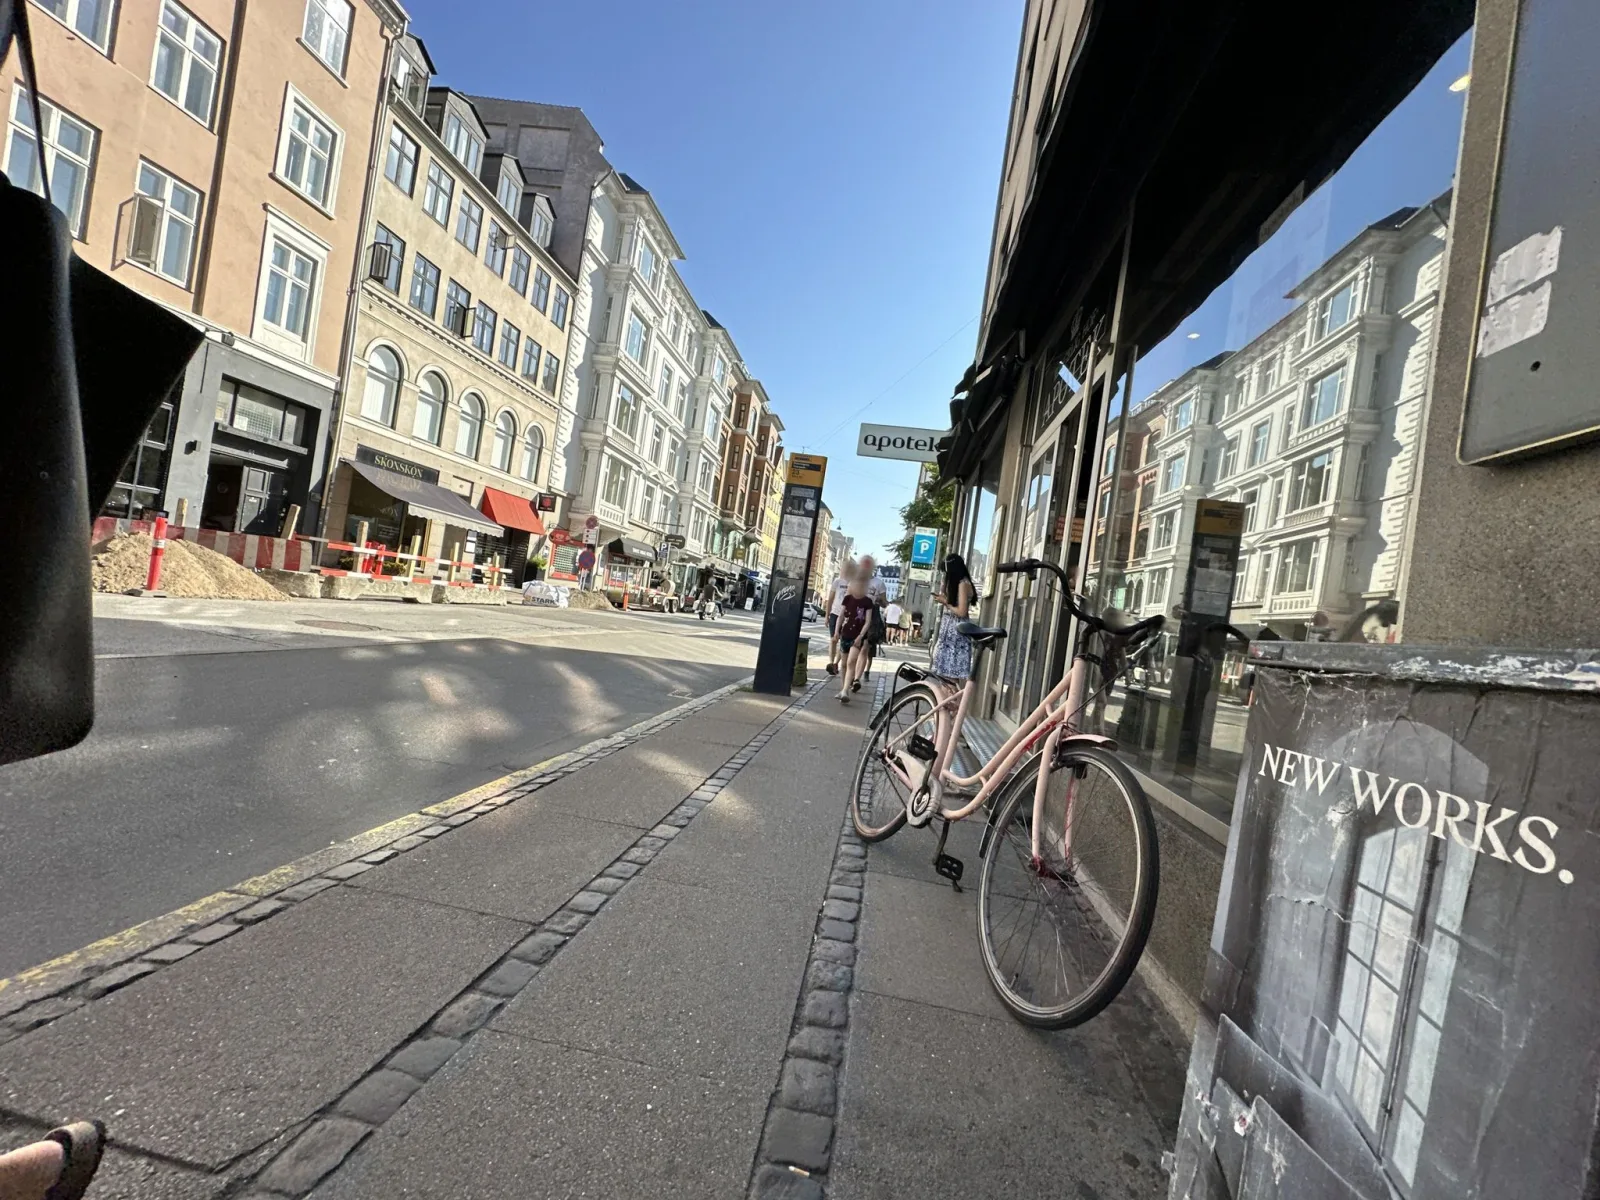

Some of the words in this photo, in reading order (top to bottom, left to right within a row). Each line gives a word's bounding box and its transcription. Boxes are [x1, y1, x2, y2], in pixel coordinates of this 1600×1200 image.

[863, 434, 940, 452] apotek
[920, 542, 930, 554] P
[531, 596, 555, 604] STARK
[1258, 743, 1341, 796] NEW
[1349, 767, 1574, 884] WORKS.
